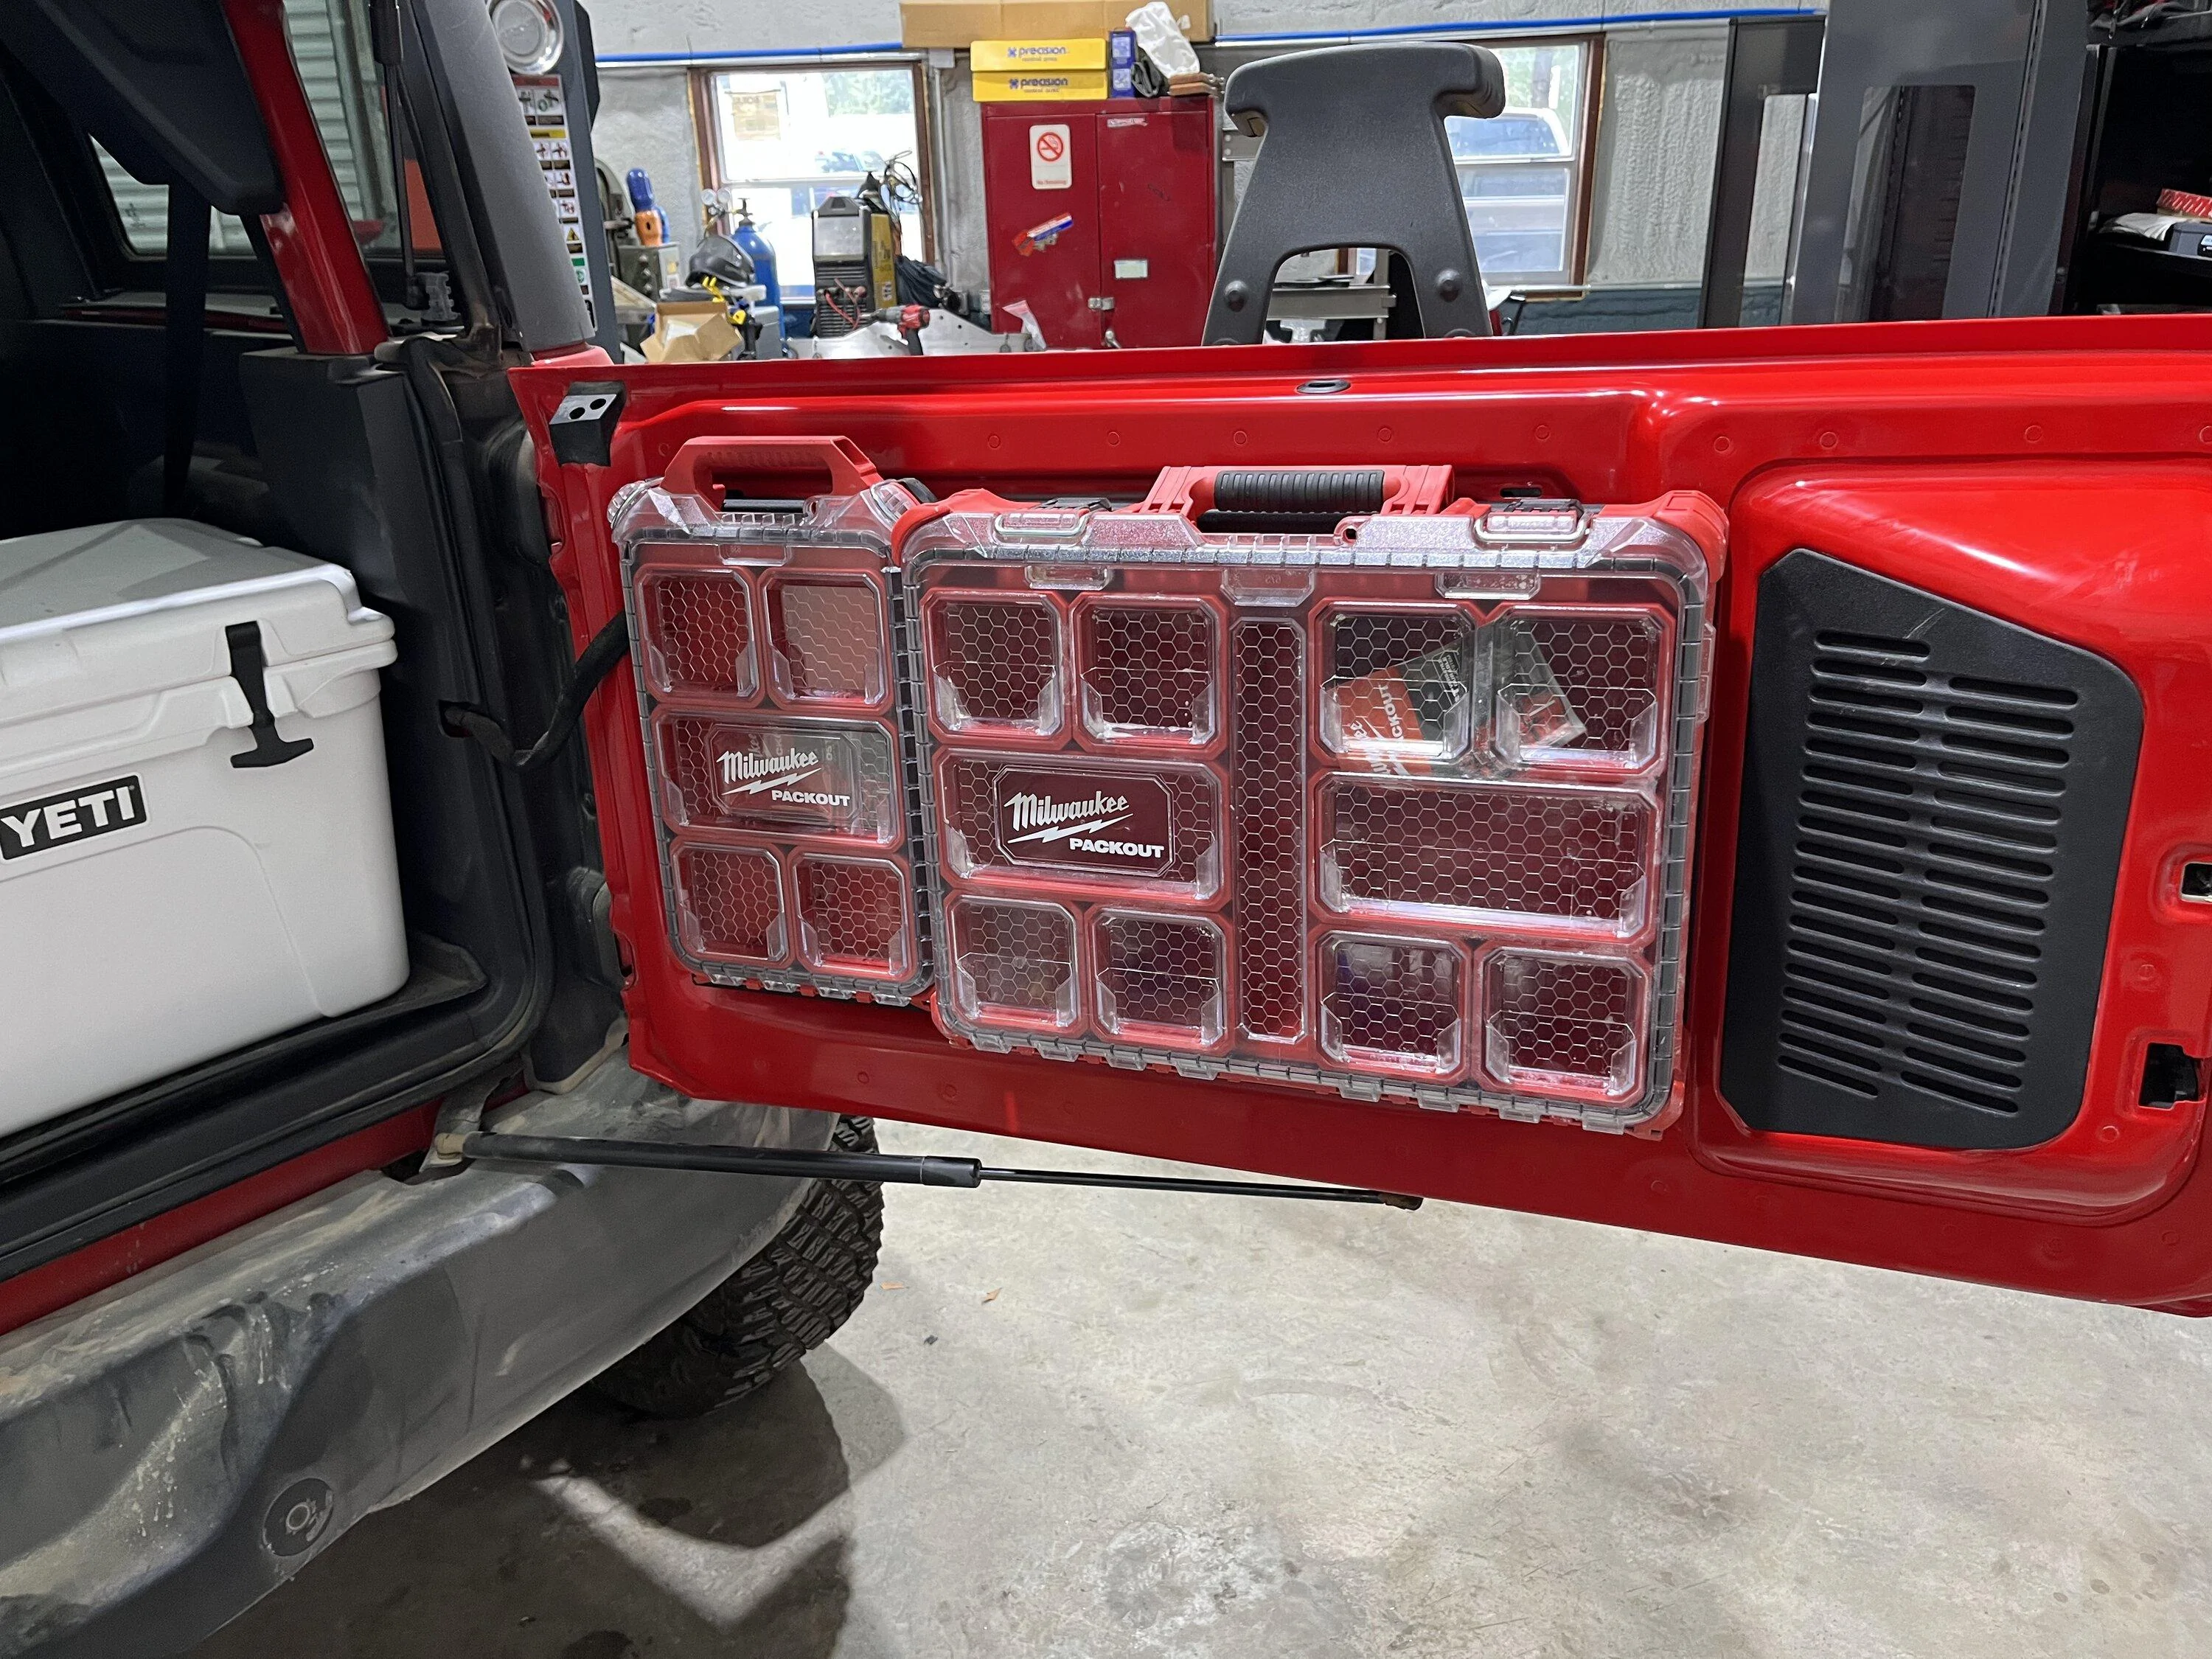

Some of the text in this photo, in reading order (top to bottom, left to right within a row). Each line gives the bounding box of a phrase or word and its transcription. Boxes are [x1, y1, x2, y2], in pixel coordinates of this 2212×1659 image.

[1019, 46, 1066, 58] precision
[1020, 77, 1068, 89] precision
[1379, 684, 1405, 740] CKOUT
[716, 748, 819, 784] Milwaukee
[772, 790, 850, 807] PACKOUT
[1004, 790, 1130, 832] Milwaukee
[0, 786, 135, 847] YETI
[1069, 838, 1164, 858] PACKOUT
